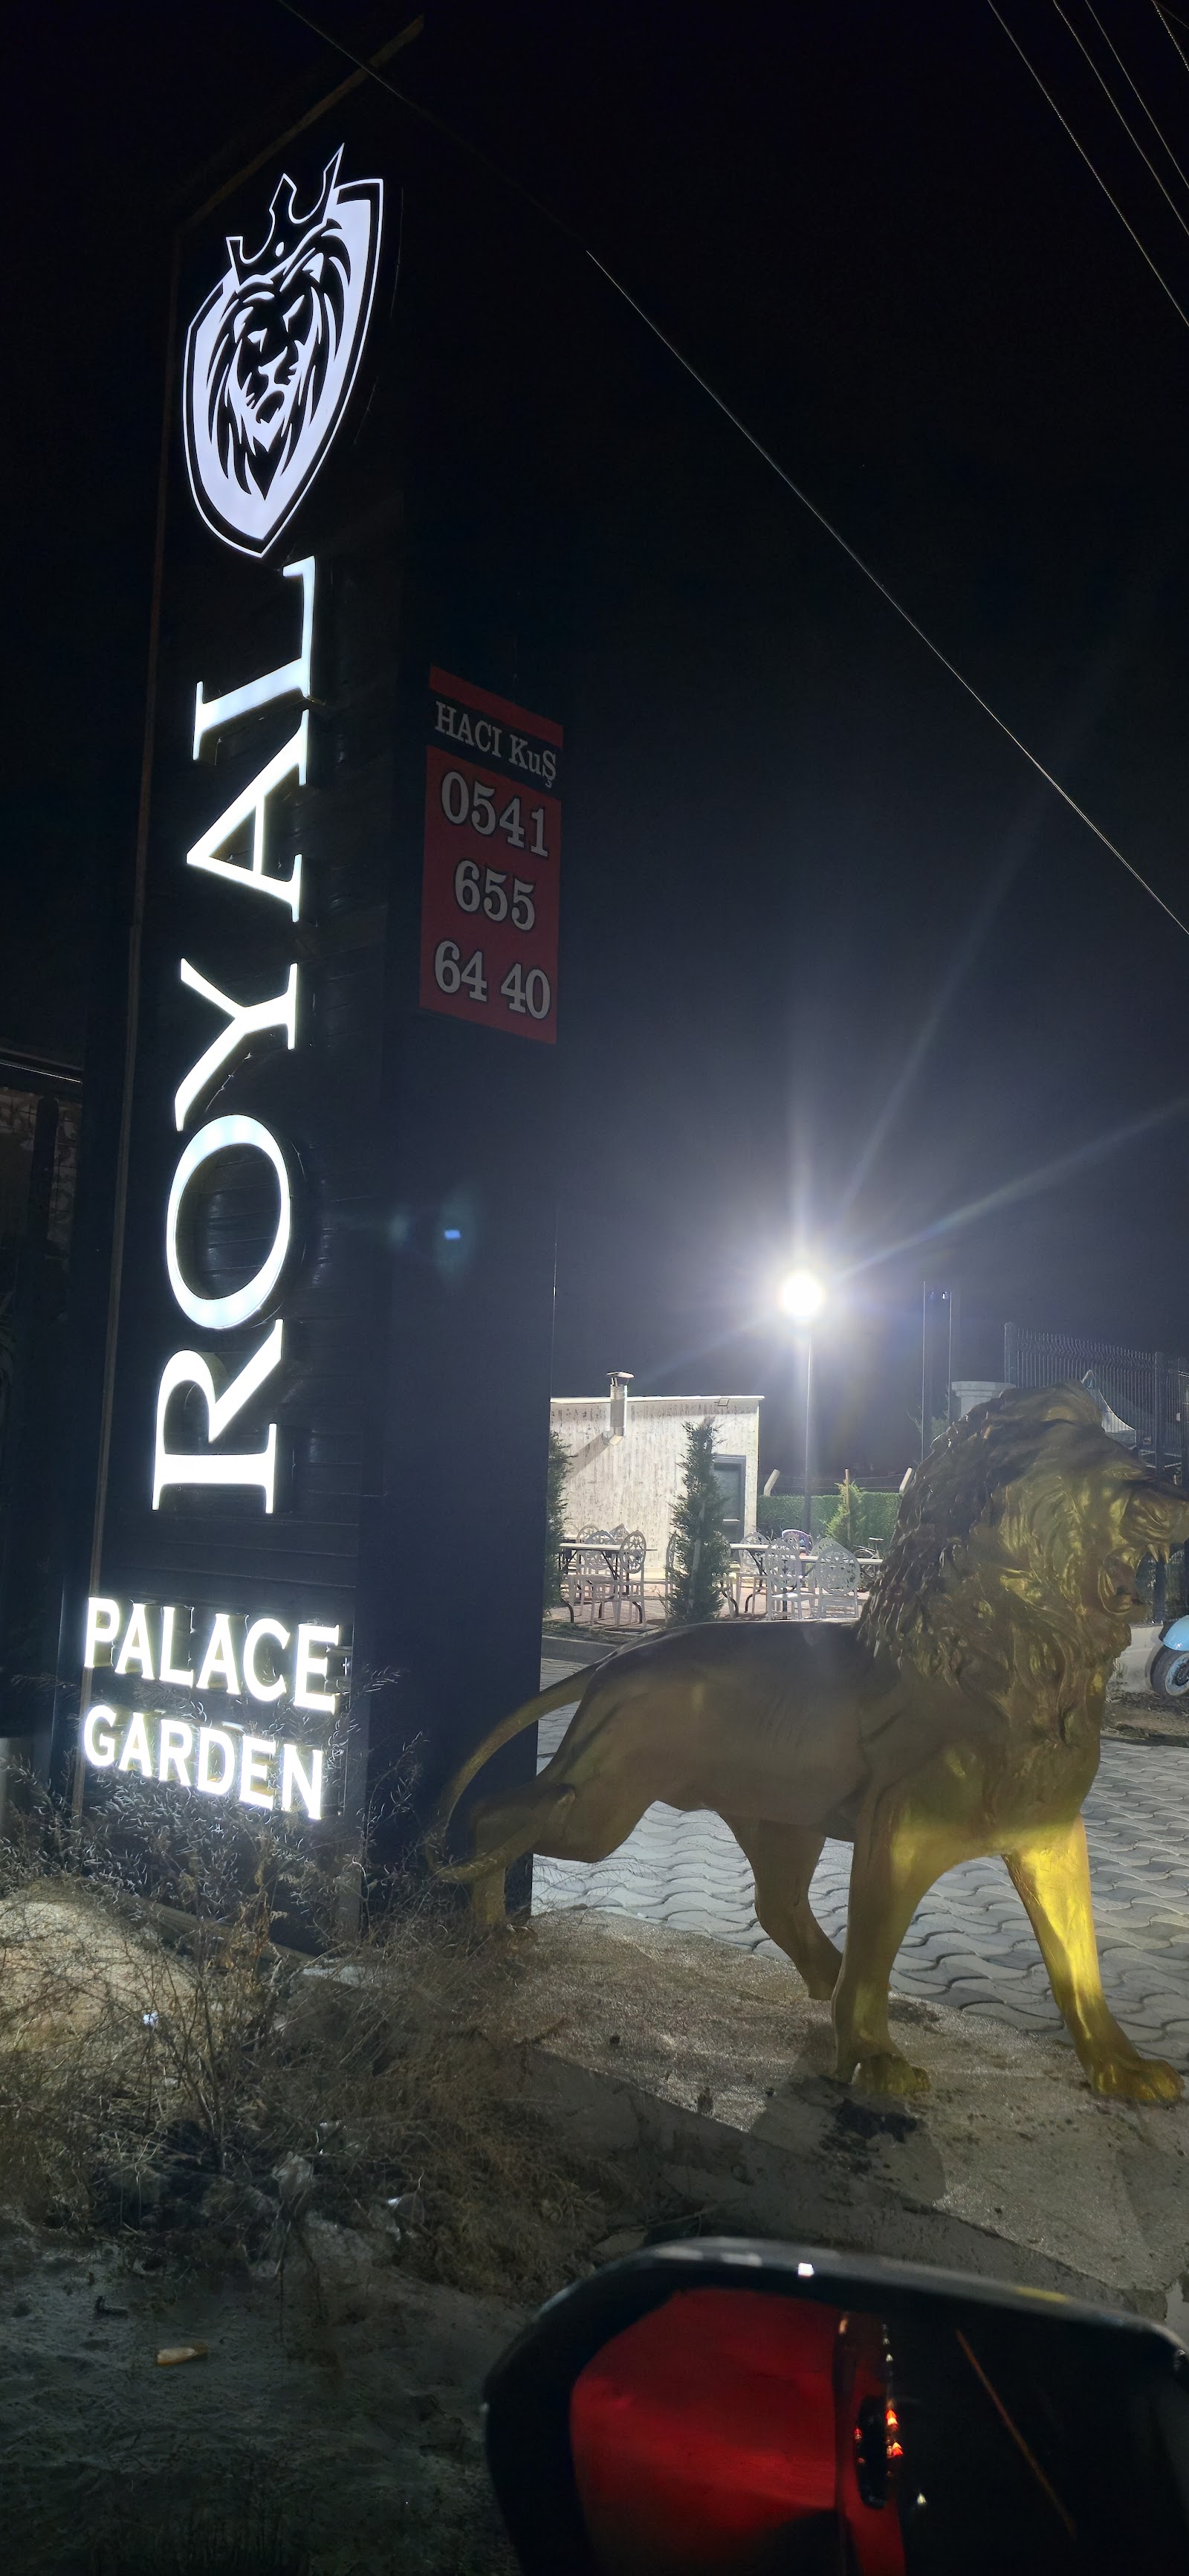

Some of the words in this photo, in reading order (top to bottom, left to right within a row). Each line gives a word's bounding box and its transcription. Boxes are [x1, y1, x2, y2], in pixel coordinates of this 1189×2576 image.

[435, 700, 502, 758] HACI
[441, 771, 549, 857] 0541
[455, 859, 535, 932] 655
[435, 940, 487, 1002] 64
[500, 963, 551, 1020] 40
[152, 555, 316, 1514] ROYAL
[84, 1596, 340, 1715] PALACE
[83, 1704, 323, 1821] GARDEN
